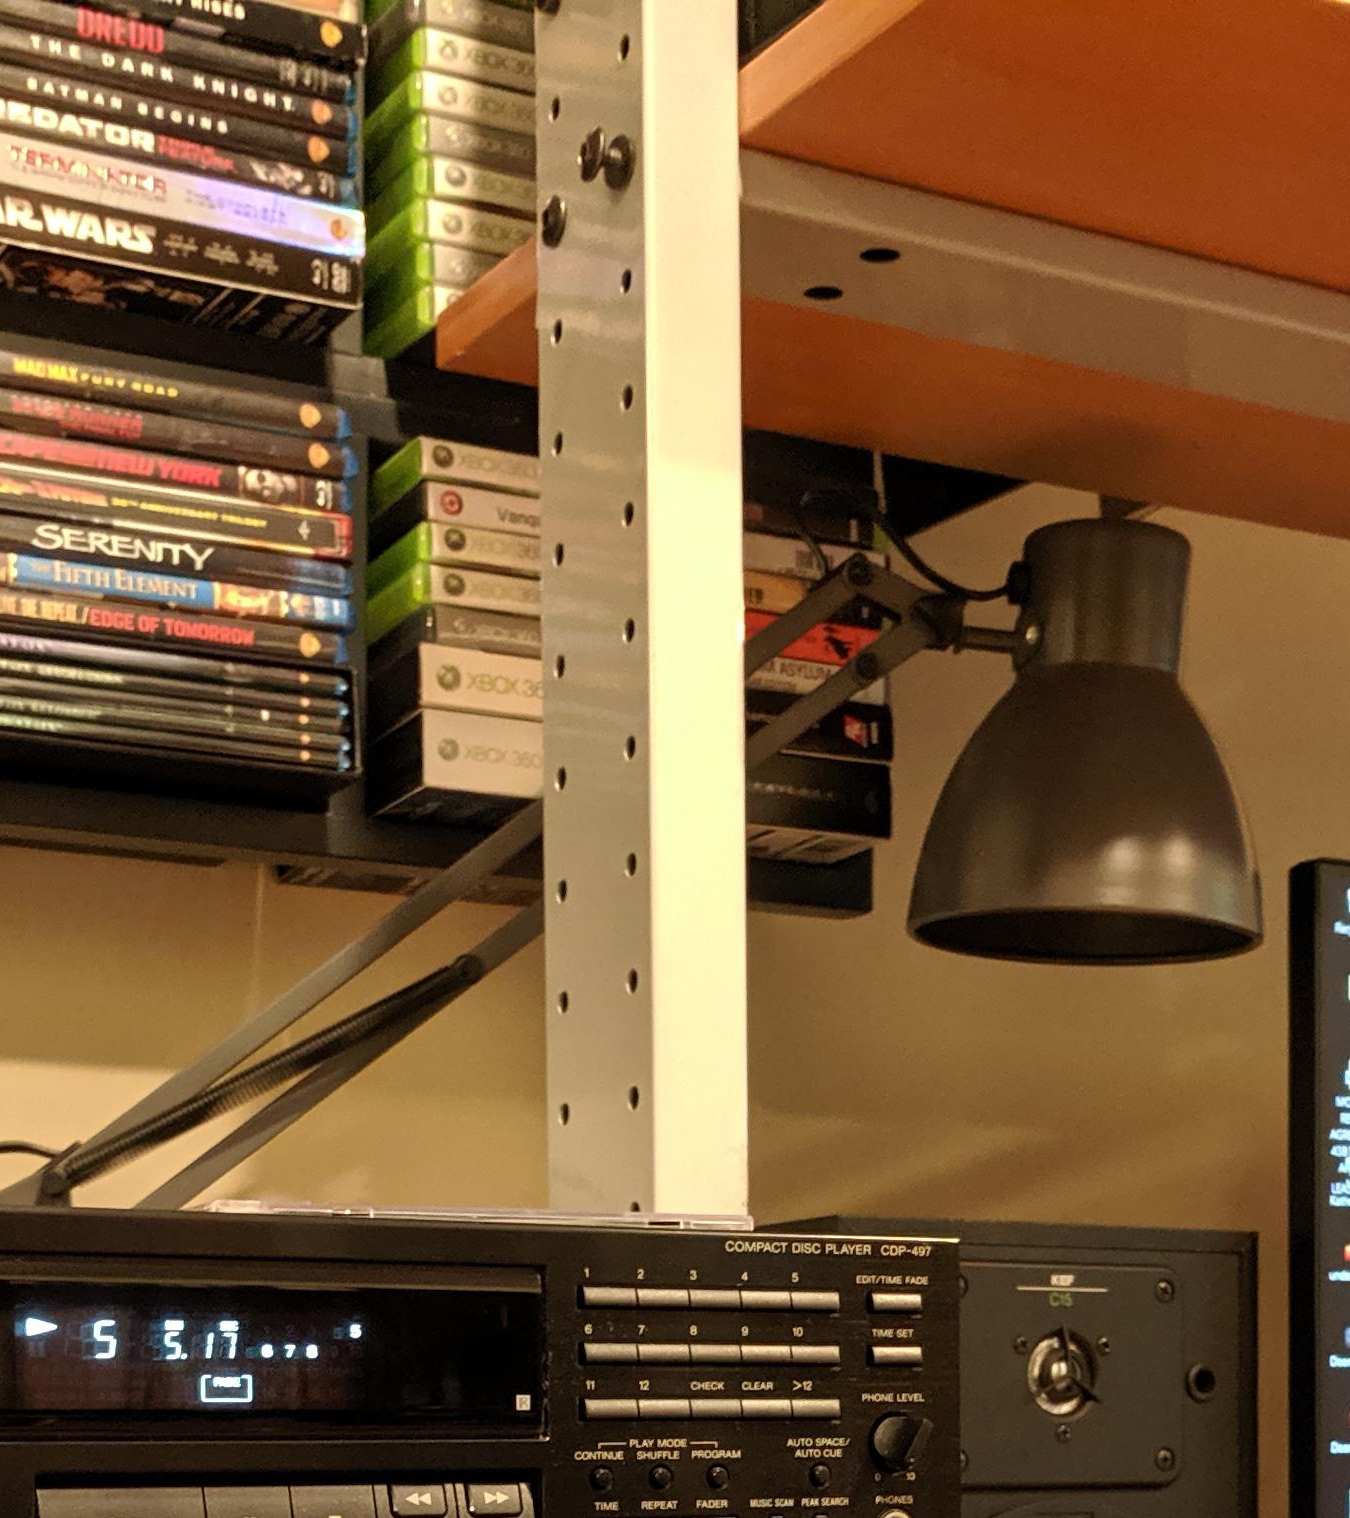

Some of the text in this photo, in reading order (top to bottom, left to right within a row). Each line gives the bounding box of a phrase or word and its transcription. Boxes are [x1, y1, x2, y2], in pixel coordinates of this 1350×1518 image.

[76, 6, 165, 54] DREDD
[30, 35, 292, 112] THE DARK KNIGHT
[27, 77, 228, 134] BATMAN BEGINS
[41, 203, 156, 254] WARS
[47, 362, 78, 383] MAX
[158, 459, 222, 487] YORK
[31, 523, 215, 571] SERENITY
[53, 560, 110, 588] FIFTH
[114, 568, 199, 600] ELEMENT
[90, 608, 134, 631] EDGE
[138, 614, 159, 634] OF
[164, 618, 254, 646] TOMORROW
[466, 672, 520, 695] XBOX
[725, 1240, 932, 1257] COMPACT DISC PLAYER CDP-497
[905, 1275, 929, 1286] FADE
[872, 1328, 913, 1338] TIME SET
[92, 1319, 116, 1360] 5
[261, 1343, 274, 1359] 6
[284, 1343, 297, 1359] 7
[305, 1343, 319, 1359] 8
[639, 1380, 649, 1391] 12
[691, 1381, 725, 1391] CHECK
[742, 1381, 774, 1391] CLEAR
[862, 1393, 924, 1403] PHONE LEVEL
[629, 1438, 687, 1449] PLAY MODE
[787, 1438, 813, 1448] AUTO
[574, 1450, 624, 1461] CONTINUE
[636, 1450, 680, 1461] SHUFFLE
[691, 1450, 741, 1460] PROGRAM
[795, 1449, 843, 1459] AUTO CUE
[641, 1500, 678, 1510] REPEAT
[696, 1499, 728, 1509] FADER
[750, 1498, 794, 1508] MUSIC SCAN
[801, 1498, 849, 1507] PEAK SEARCH
[875, 1495, 913, 1505] PHONES
[594, 1501, 619, 1511] TIME
